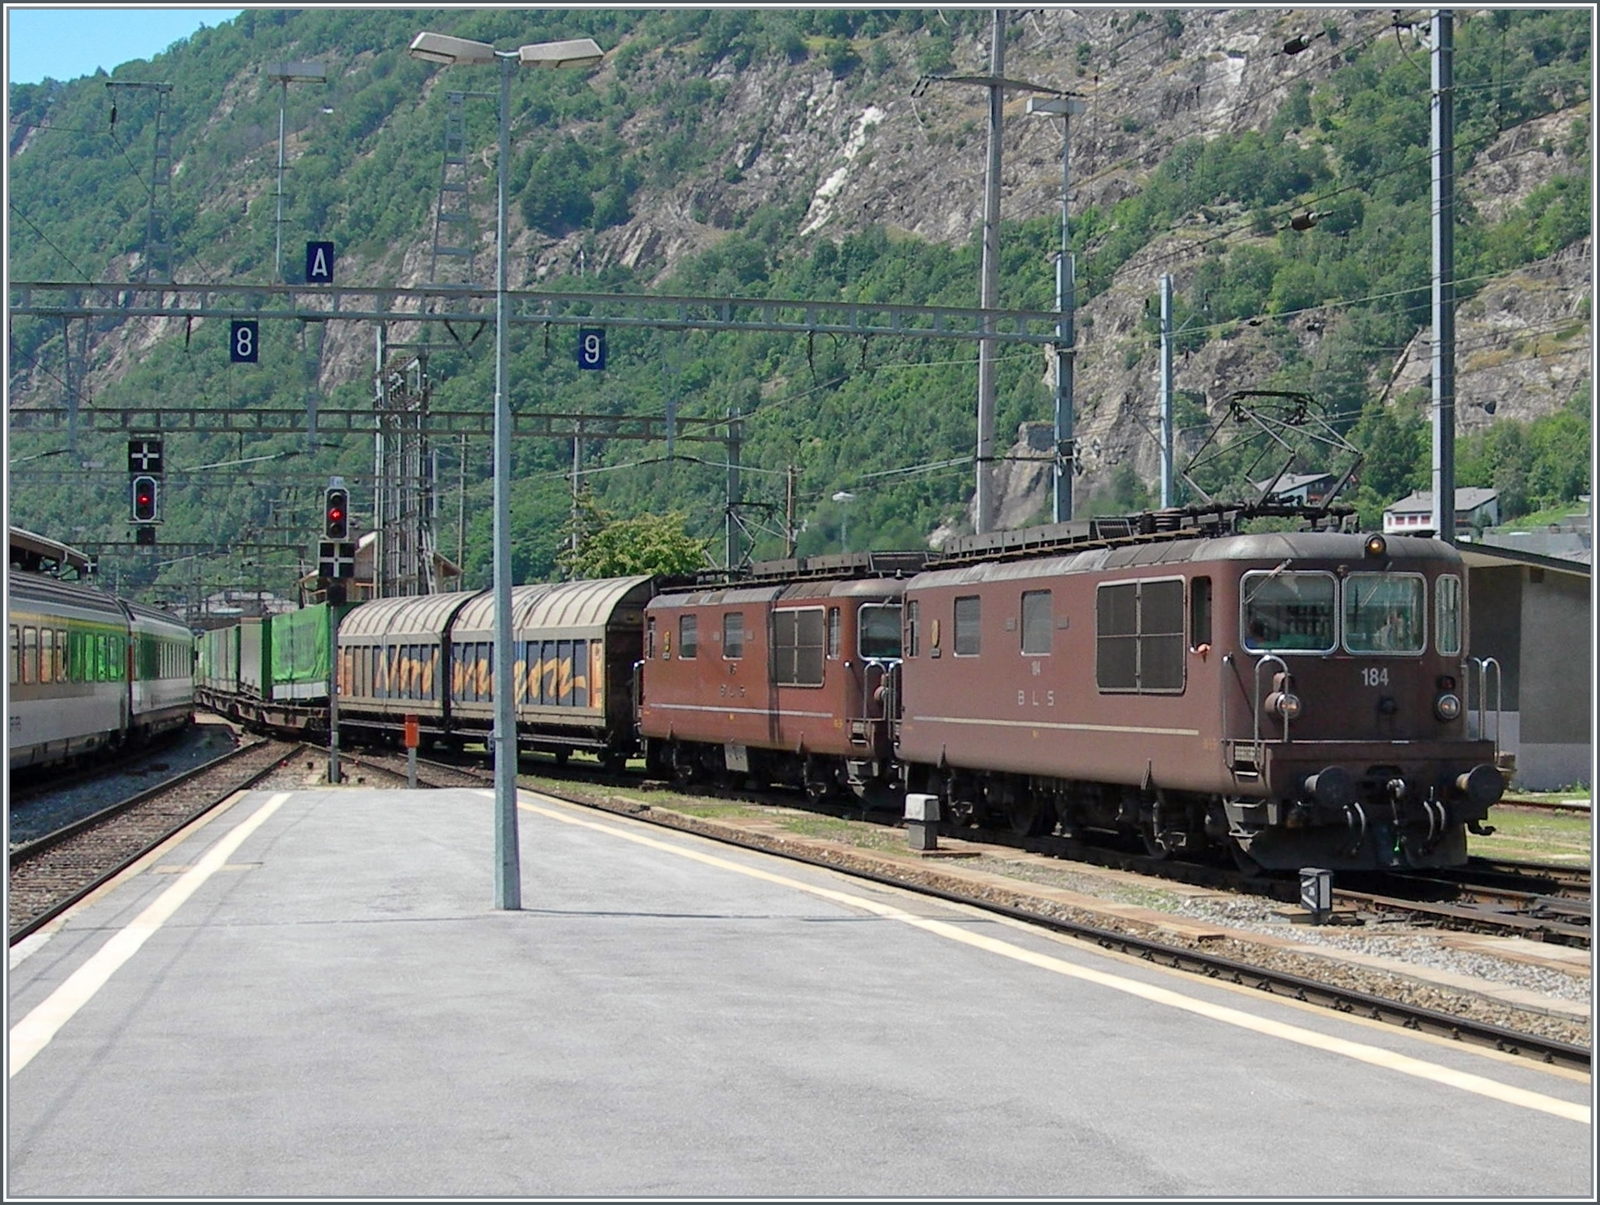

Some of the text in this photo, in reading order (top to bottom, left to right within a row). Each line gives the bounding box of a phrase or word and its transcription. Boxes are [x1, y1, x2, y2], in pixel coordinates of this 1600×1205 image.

[311, 247, 328, 277] A
[237, 326, 252, 357] 8
[584, 334, 600, 364] 9
[1361, 667, 1390, 687] 184
